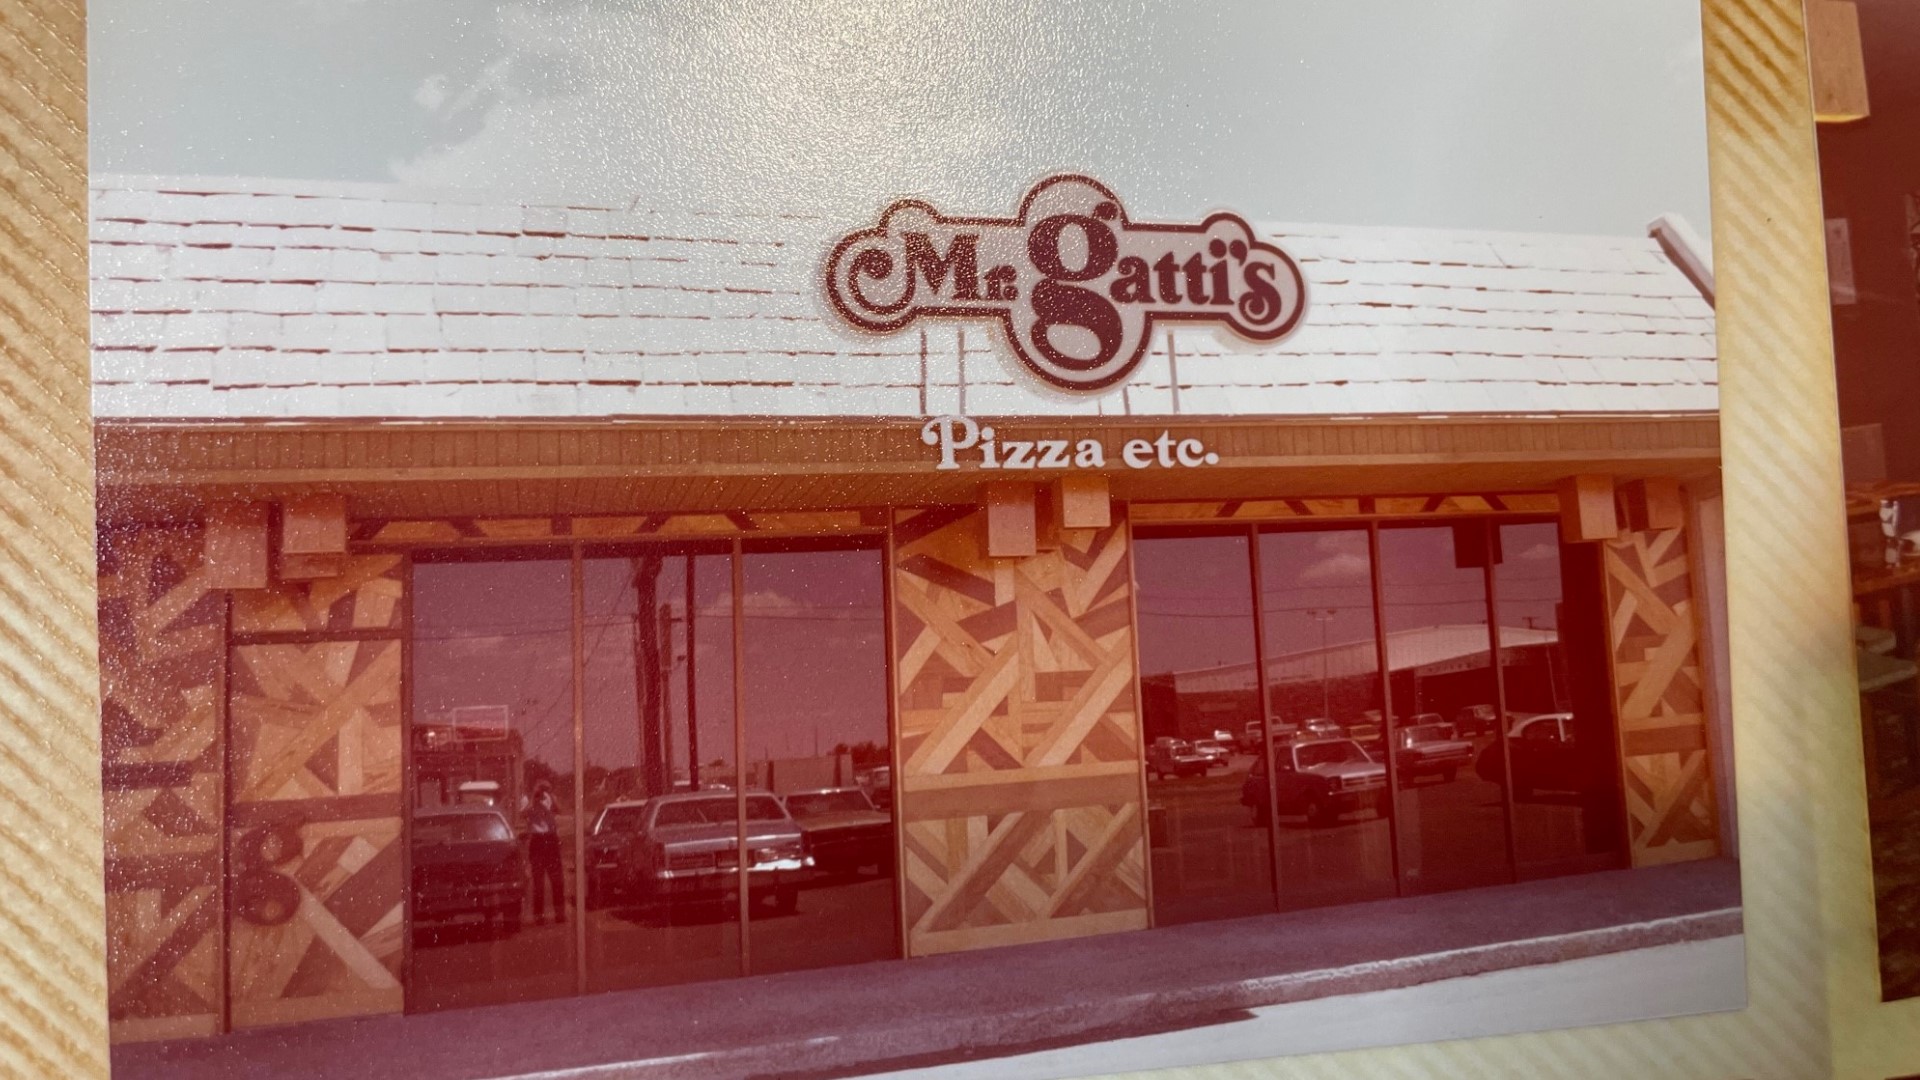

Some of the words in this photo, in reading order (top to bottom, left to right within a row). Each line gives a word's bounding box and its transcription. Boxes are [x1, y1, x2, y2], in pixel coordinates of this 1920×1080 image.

[847, 231, 1018, 315] Mr.
[921, 414, 1106, 470] Pizza
[1122, 430, 1220, 468] etc.
